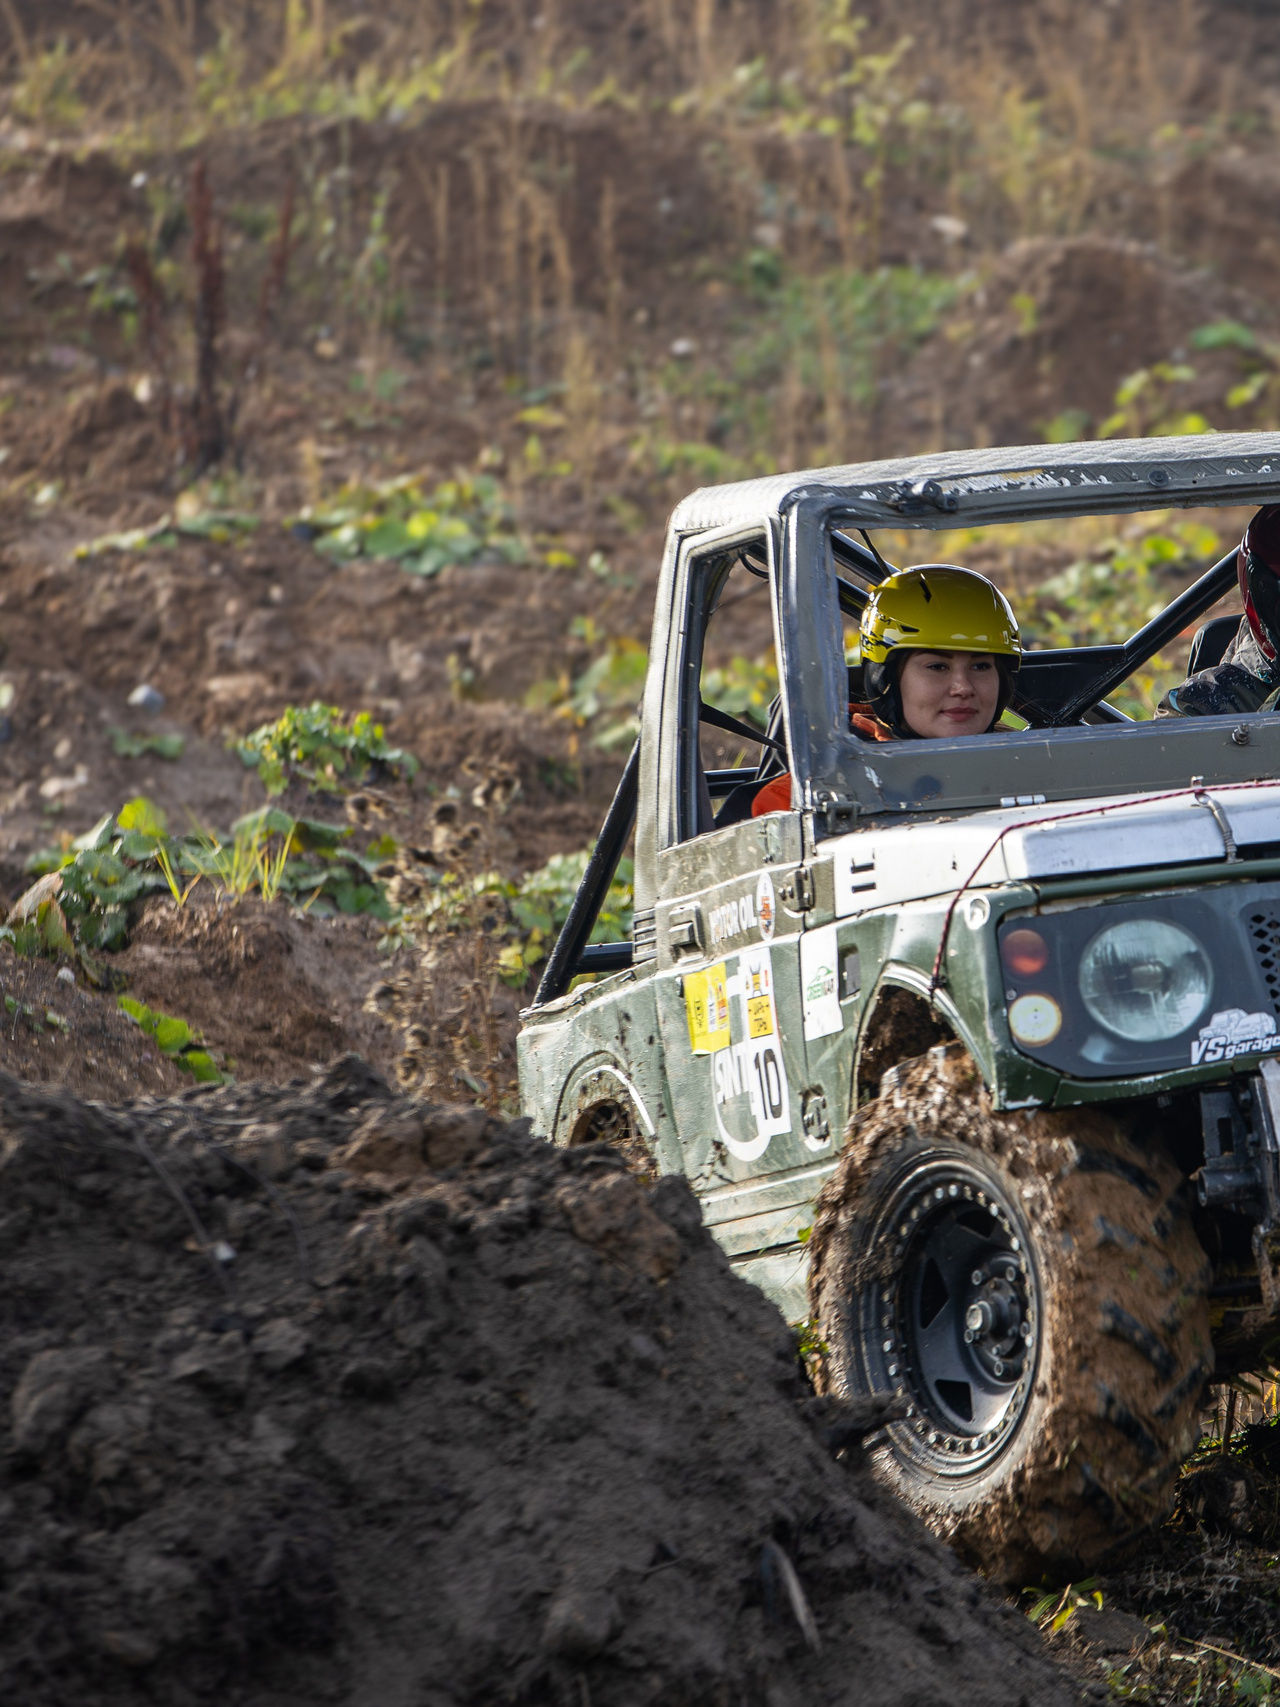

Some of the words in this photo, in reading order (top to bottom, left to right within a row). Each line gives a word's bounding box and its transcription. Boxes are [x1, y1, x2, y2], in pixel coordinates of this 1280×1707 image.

[739, 894, 758, 931] OIL
[714, 1040, 751, 1105] SINT
[1190, 1035, 1228, 1066] VS
[754, 1048, 783, 1120] 10
